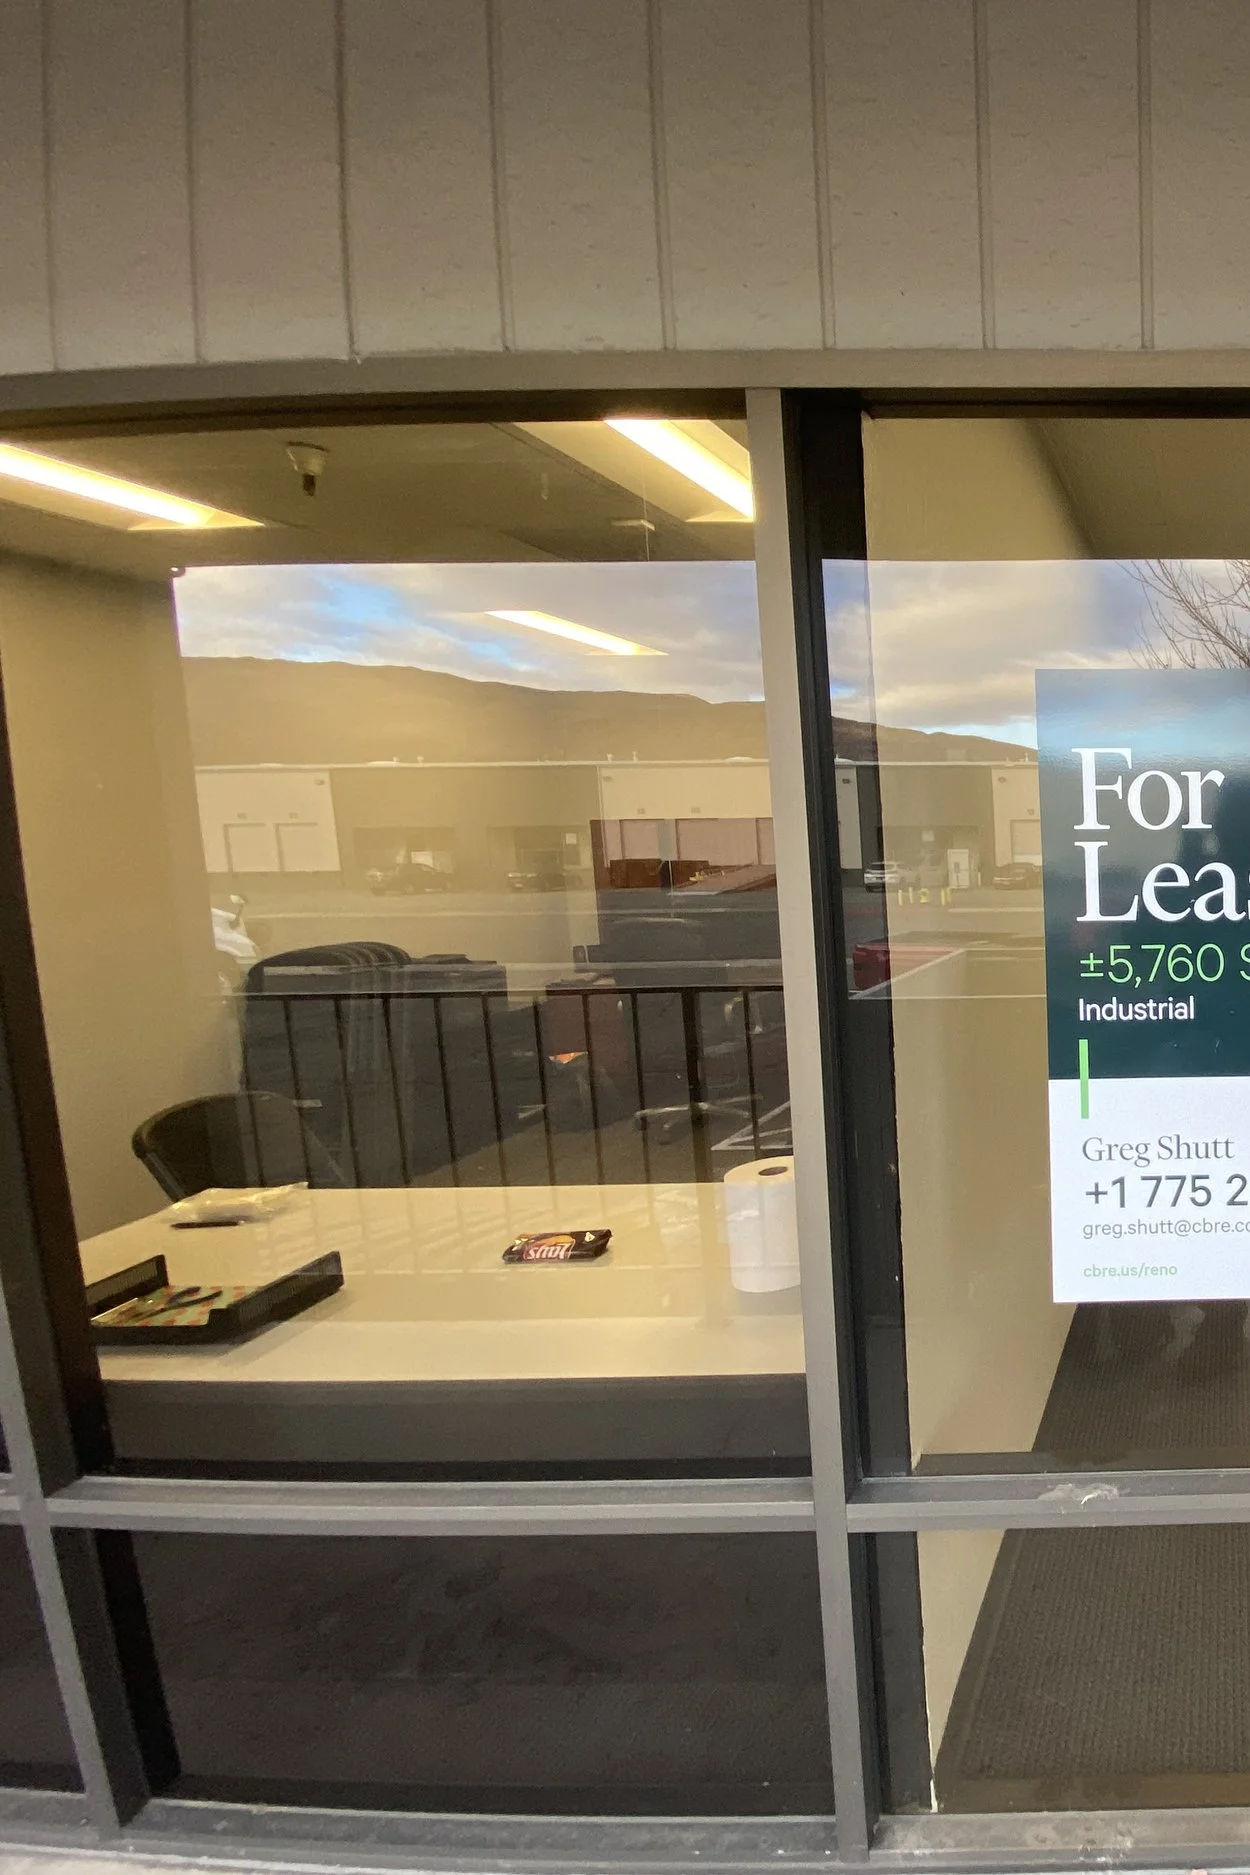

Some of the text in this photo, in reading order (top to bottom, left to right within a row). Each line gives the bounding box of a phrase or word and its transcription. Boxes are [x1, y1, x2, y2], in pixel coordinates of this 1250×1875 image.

[1071, 747, 1225, 831] For
[1079, 943, 1225, 989] ±5,760
[1078, 996, 1195, 1021] Industrial
[1081, 1134, 1236, 1168] Greg Shutt
[1085, 1175, 1127, 1209] +1
[1139, 1174, 1212, 1207] 775
[1083, 1262, 1178, 1278] cbre.us/reno
